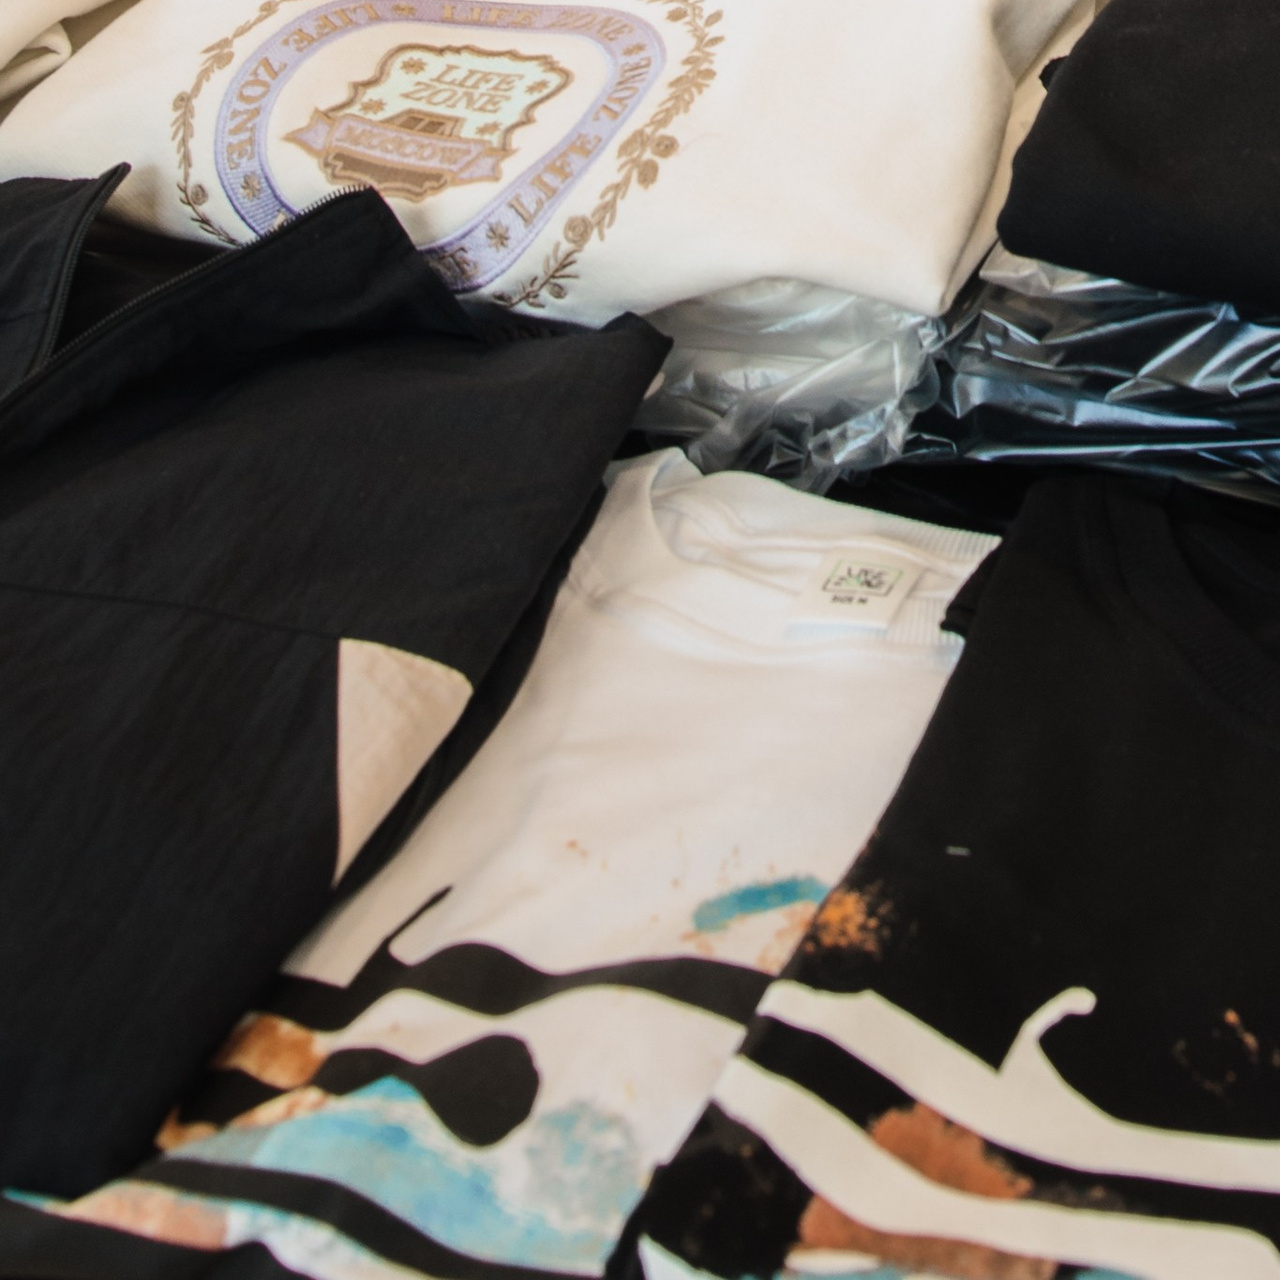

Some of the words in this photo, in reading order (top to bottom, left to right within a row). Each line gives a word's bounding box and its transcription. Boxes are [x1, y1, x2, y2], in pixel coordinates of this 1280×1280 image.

[281, 2, 381, 52] LIFE
[442, 4, 541, 28] LIFE
[400, 81, 512, 113] ZONE
[430, 64, 525, 92] LIFE
[226, 56, 288, 170] ZONE
[508, 132, 602, 228] LIFE
